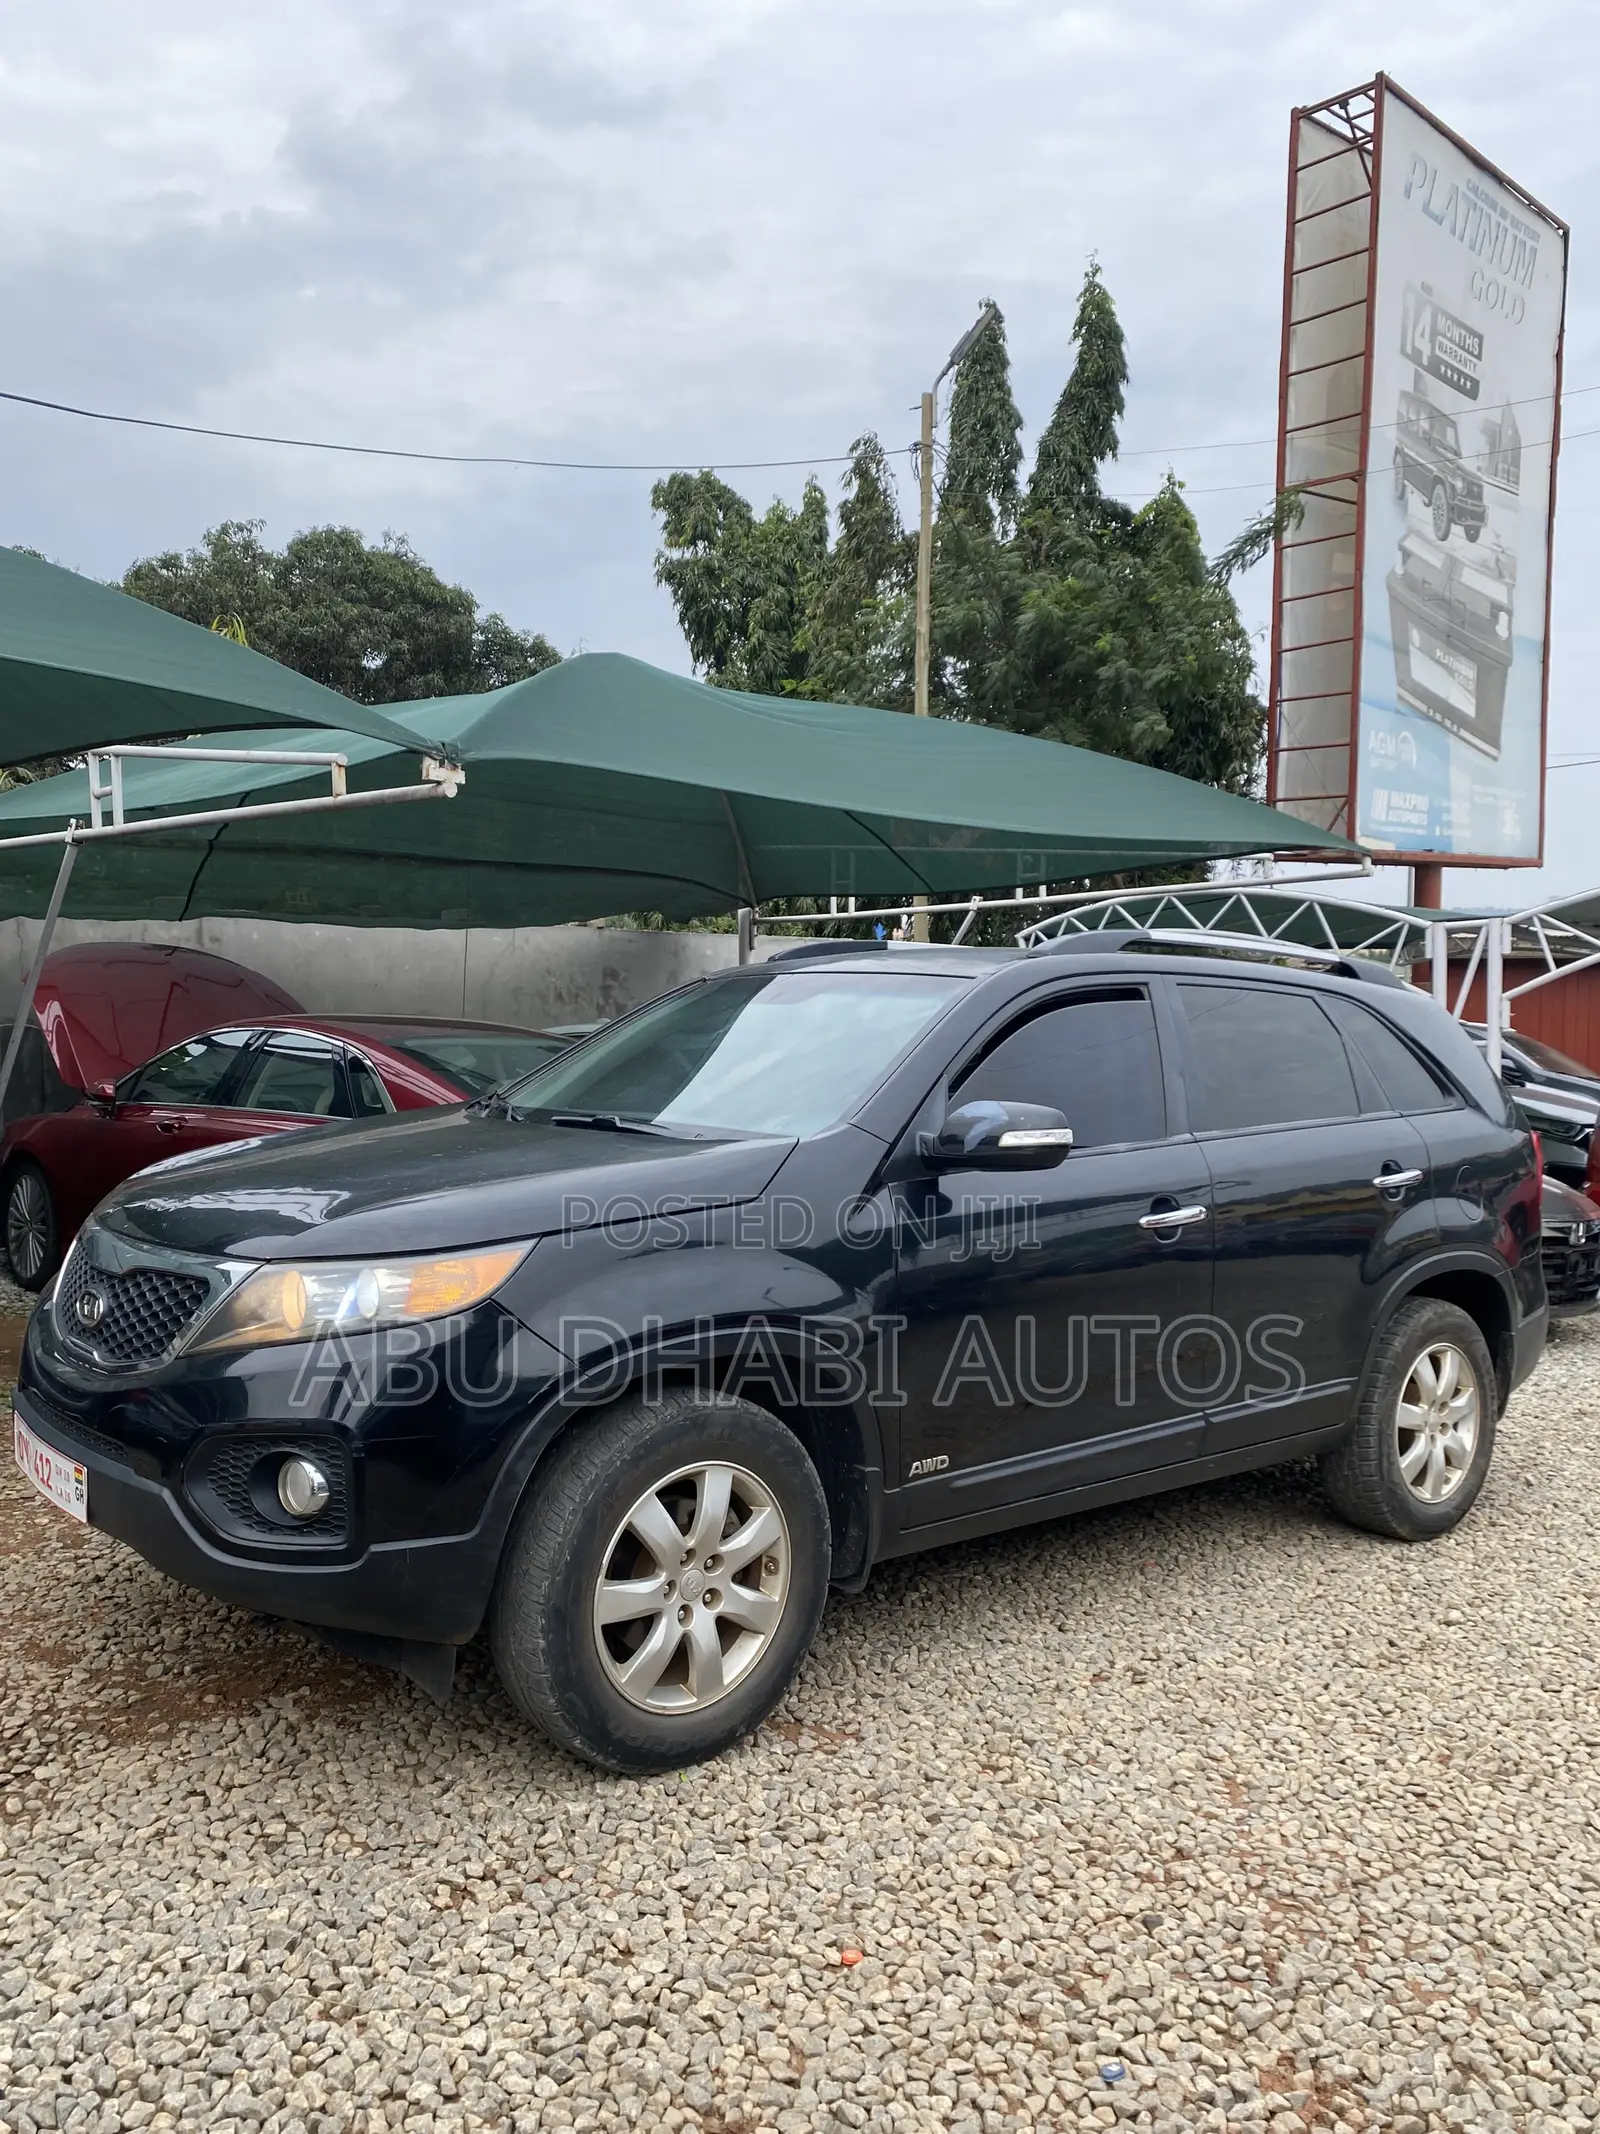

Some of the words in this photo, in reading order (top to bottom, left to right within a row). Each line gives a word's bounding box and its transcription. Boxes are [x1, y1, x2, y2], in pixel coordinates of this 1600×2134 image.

[1403, 151, 1538, 290] PLATINUM
[1470, 267, 1526, 326] GOLD
[1404, 292, 1433, 367] 14
[1437, 313, 1480, 356] MONTHS
[1438, 340, 1478, 374] WARRANTY
[1368, 730, 1396, 756] AGM
[34, 1449, 53, 1492] 412
[908, 1455, 950, 1478] AWD
